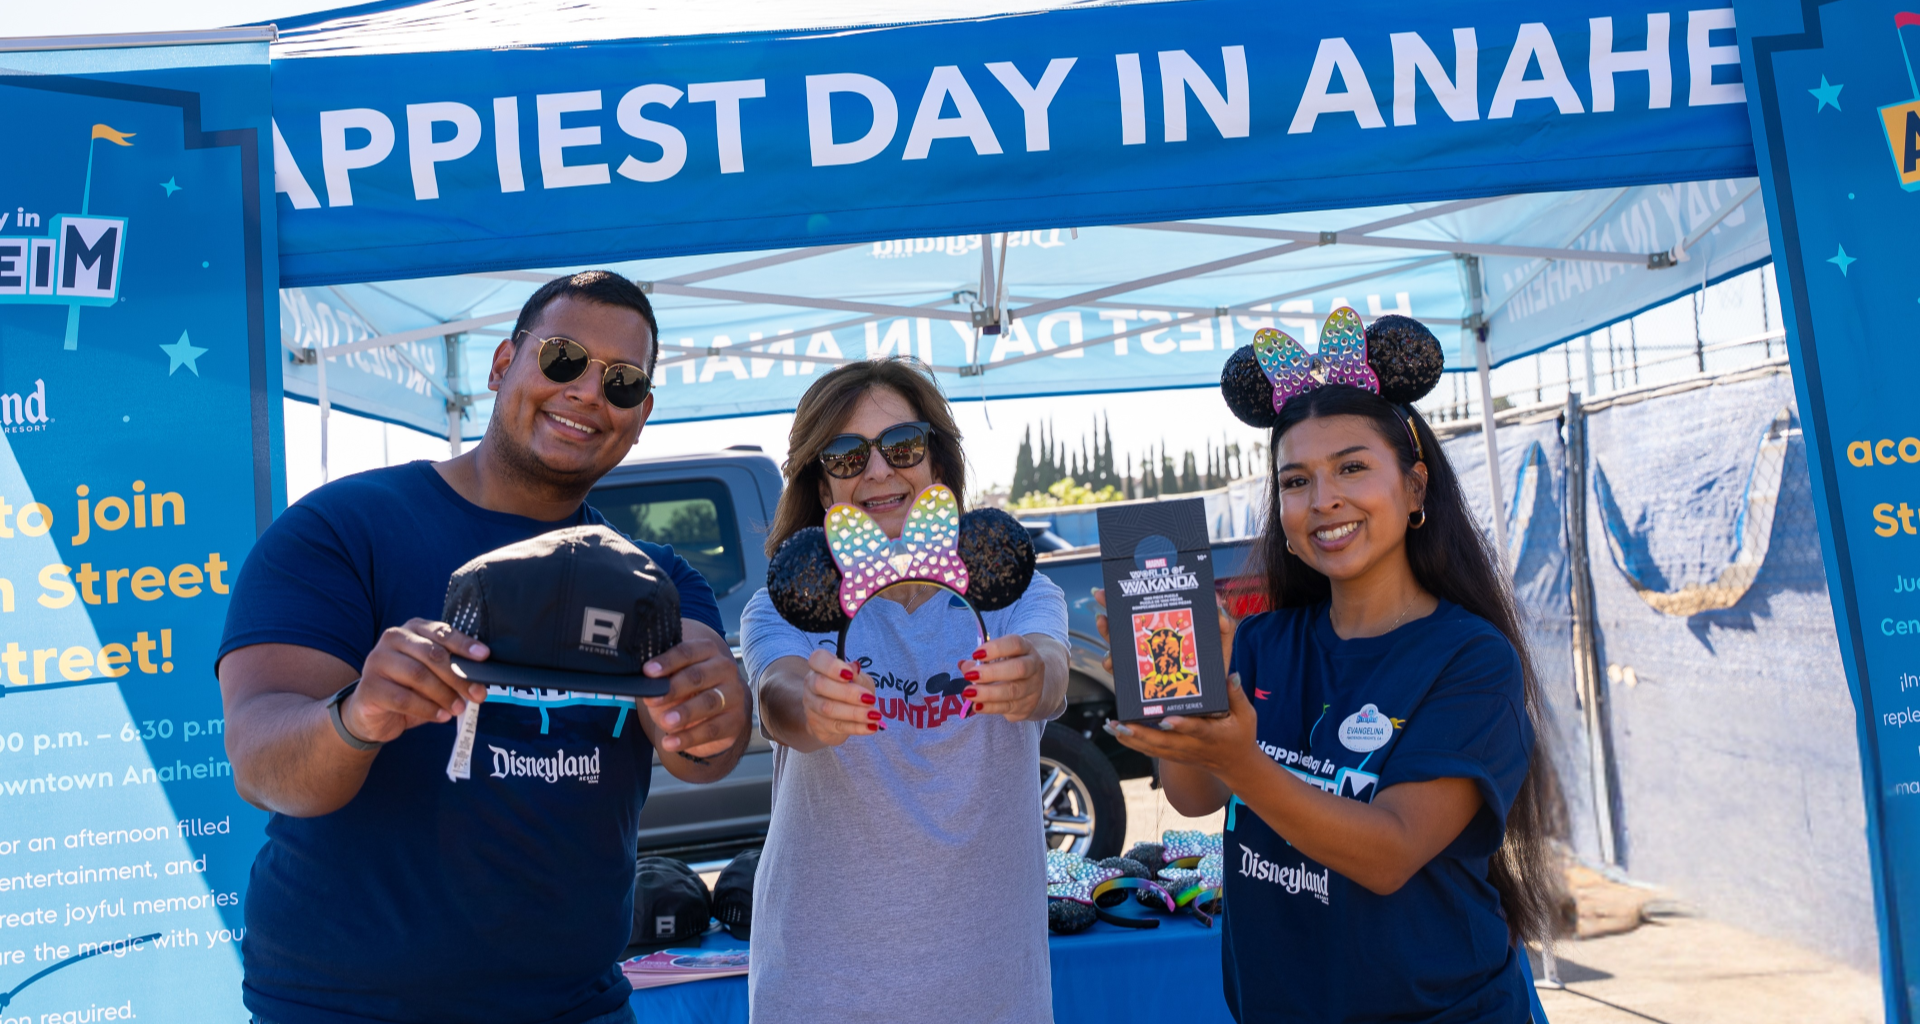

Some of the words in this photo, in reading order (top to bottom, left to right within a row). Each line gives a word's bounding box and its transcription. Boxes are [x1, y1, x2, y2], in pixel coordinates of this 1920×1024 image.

[805, 58, 1078, 168] DAY
[1115, 45, 1250, 146] IN
[17, 206, 41, 228] in
[5, 424, 47, 434] RESORT
[0, 496, 54, 538] to
[72, 479, 186, 546] join
[1873, 503, 1920, 538] St
[37, 552, 230, 610] Street
[1129, 567, 1170, 579] WORLD
[1171, 565, 1186, 574] OF
[1145, 558, 1167, 569] MARVEL
[1119, 574, 1200, 595] WAKANDA
[0, 628, 174, 685] treet!
[1185, 702, 1203, 710] SERIES
[34, 731, 89, 756] p.m.
[120, 718, 174, 742] 6:30
[1347, 727, 1384, 735] EVANGELINA
[0, 771, 113, 796] owntown
[122, 756, 232, 786] Anaheim
[488, 744, 601, 783] Disneyland
[1321, 758, 1335, 775] in
[28, 837, 56, 852] an
[64, 824, 169, 849] afternoon
[176, 815, 231, 838] filled
[0, 860, 158, 892] entertainment,
[164, 853, 207, 876] and
[1238, 842, 1329, 896] Disneyland
[64, 898, 126, 926] joyful
[133, 889, 239, 915] memories
[0, 949, 25, 966] re
[34, 942, 70, 961] the
[78, 933, 145, 958] magic
[152, 928, 198, 949] with
[206, 926, 247, 949] you
